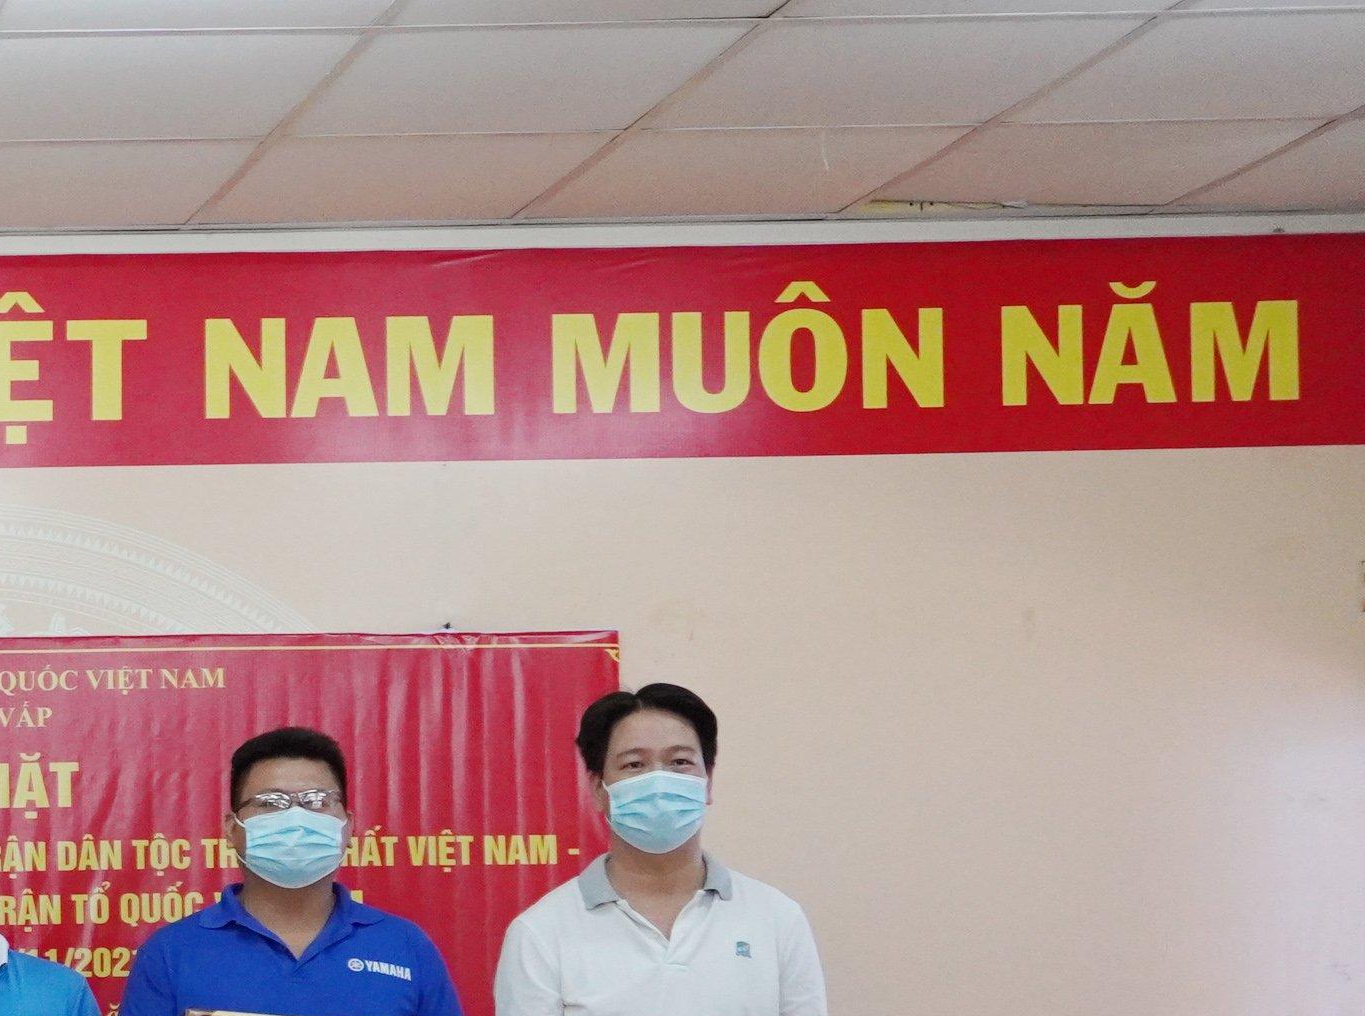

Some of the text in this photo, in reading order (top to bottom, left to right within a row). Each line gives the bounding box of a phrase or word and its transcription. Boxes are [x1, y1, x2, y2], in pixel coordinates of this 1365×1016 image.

[203, 315, 495, 420] NAM
[552, 280, 945, 414] MUÔN
[1001, 279, 1301, 406] NĂM
[85, 666, 153, 695] VIỆT
[159, 667, 226, 689] NAM
[57, 833, 122, 871] DÂN
[132, 833, 191, 876] TỘC
[407, 829, 474, 873] VIỆT
[483, 834, 558, 865] NAM
[71, 881, 111, 925] TỔ
[364, 959, 412, 981] YAMAHA
